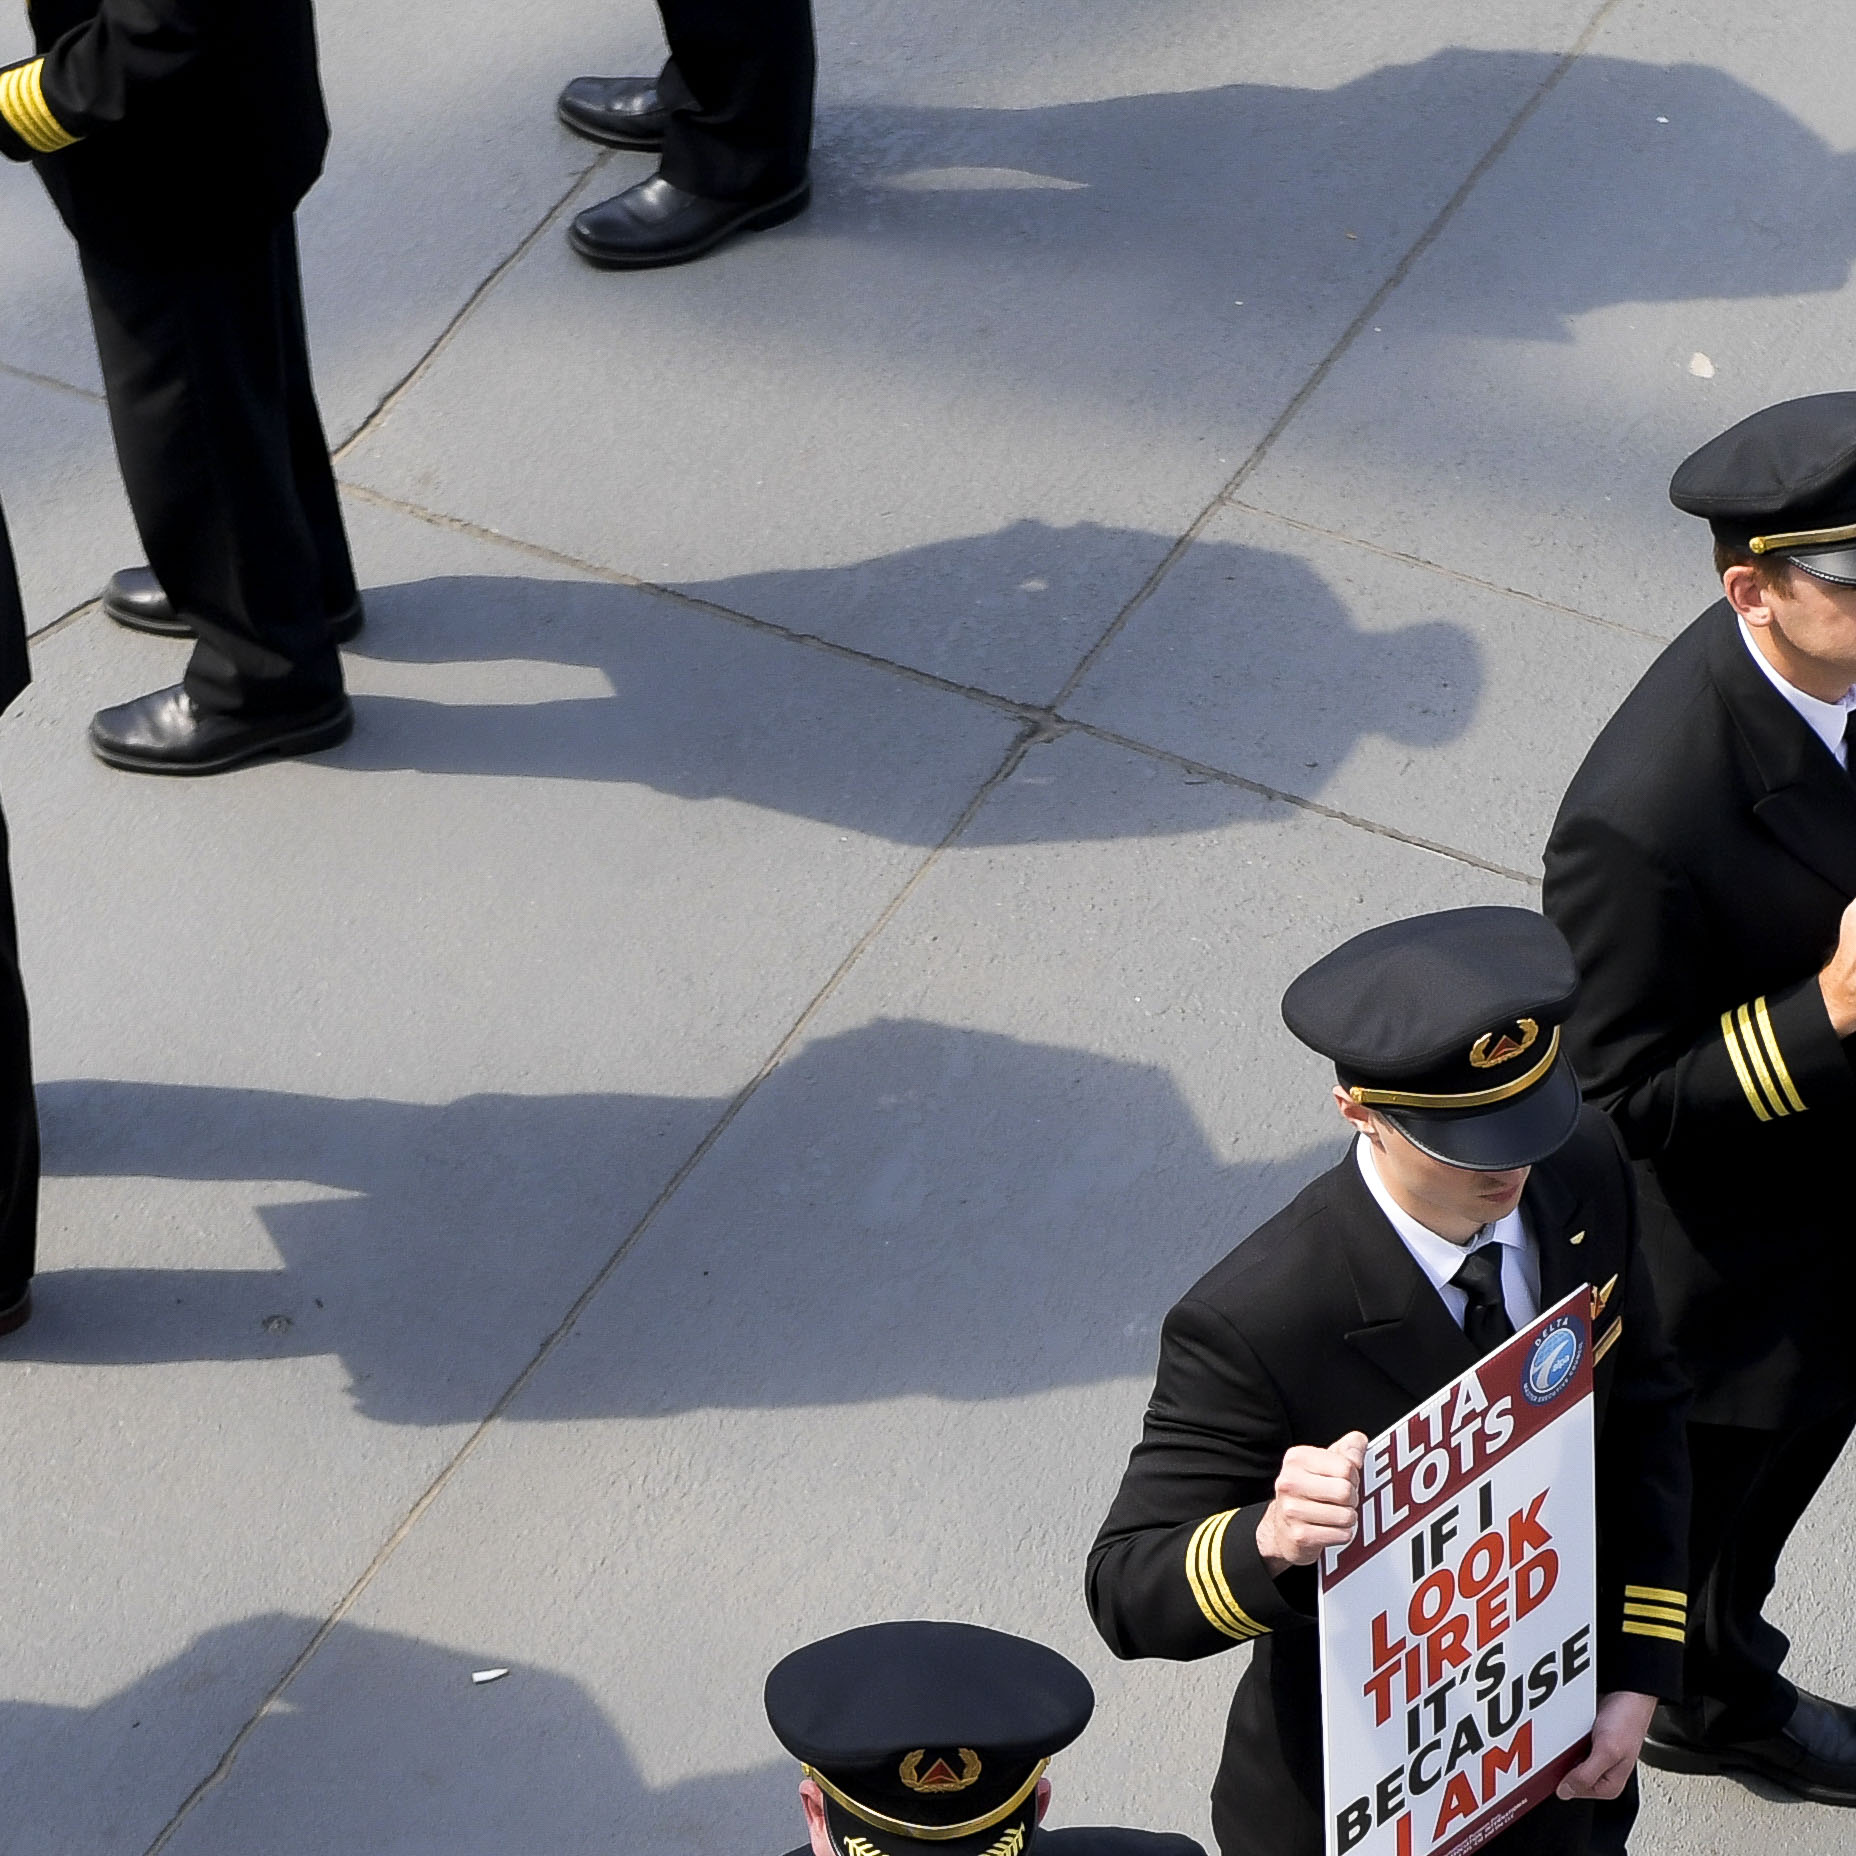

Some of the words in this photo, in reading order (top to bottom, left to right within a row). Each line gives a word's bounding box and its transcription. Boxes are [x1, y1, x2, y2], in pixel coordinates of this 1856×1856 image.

[1534, 1317, 1569, 1347] DELTA
[1363, 1370, 1489, 1497] ELTA
[1371, 1486, 1553, 1673] LOOK
[1411, 1504, 1460, 1583] IF
[1478, 1480, 1493, 1534] I
[1363, 1548, 1560, 1728] TIRED
[1406, 1643, 1505, 1756] IT'S
[1432, 1718, 1534, 1843] AM
